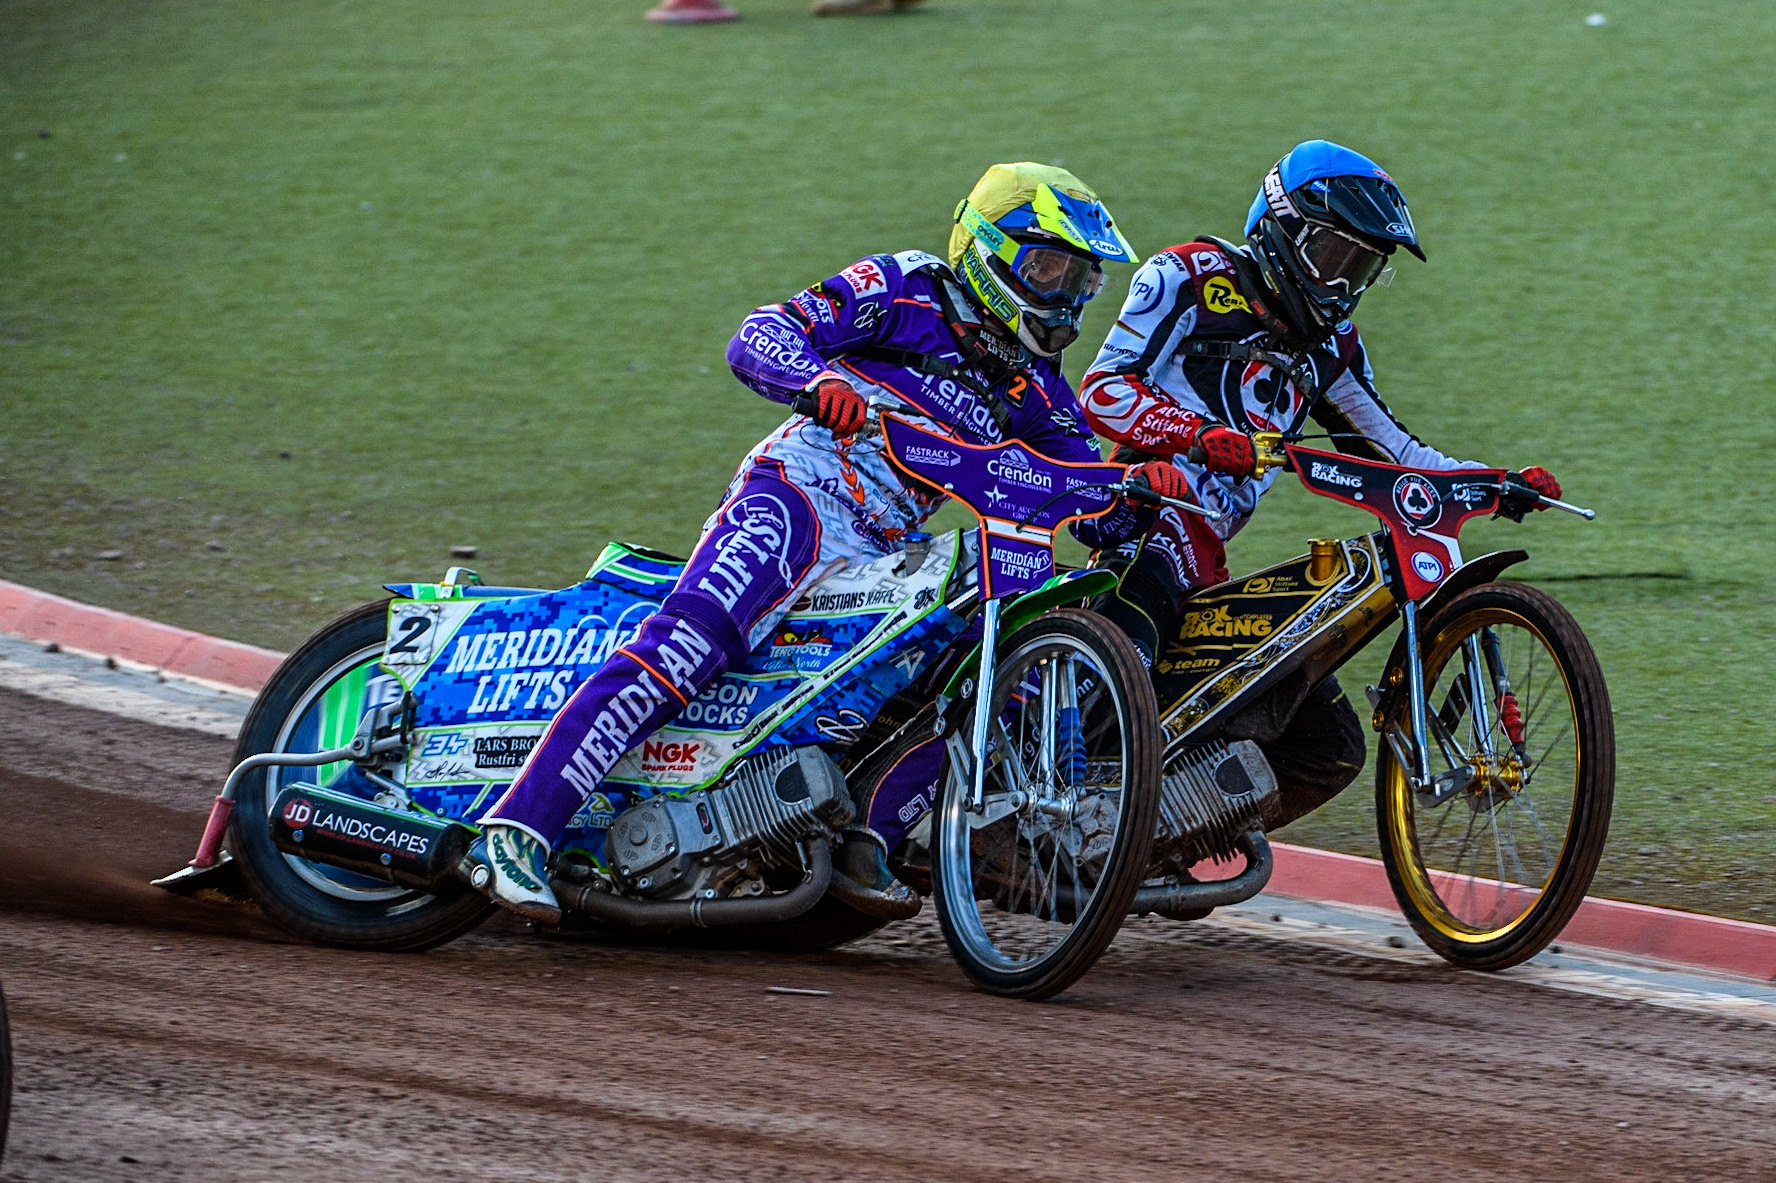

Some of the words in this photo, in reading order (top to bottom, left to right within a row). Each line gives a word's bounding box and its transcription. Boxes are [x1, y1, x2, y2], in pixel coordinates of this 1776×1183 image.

[850, 263, 885, 291] GK
[920, 384, 956, 415] TIMBER
[1007, 375, 1028, 401] 2
[906, 445, 950, 459] FASTRACK
[986, 459, 1052, 488] Crendon
[1311, 470, 1363, 488] RACING
[998, 501, 1015, 511] CITY
[698, 519, 783, 612] LIFTS
[990, 547, 1042, 569] MERIDIAN
[1418, 561, 1438, 572] ATPI
[1000, 563, 1030, 580] LIFTS
[811, 592, 865, 612] KRISTIANS
[865, 588, 896, 606] KAFFE
[389, 615, 432, 654] 2
[1179, 620, 1272, 639] RACING
[443, 629, 632, 674] MERIDIAN
[1174, 657, 1221, 670] team
[466, 669, 575, 714] LIFTS
[560, 619, 712, 800] MERIDIAN
[421, 732, 469, 757] 34
[476, 738, 508, 752] LARS
[642, 740, 701, 765] NGK
[478, 753, 516, 766] Rustfri
[641, 763, 667, 772] SPARK
[668, 764, 695, 772] PLUGS
[284, 803, 311, 823] JD
[312, 809, 430, 855] LANDSCAPES
